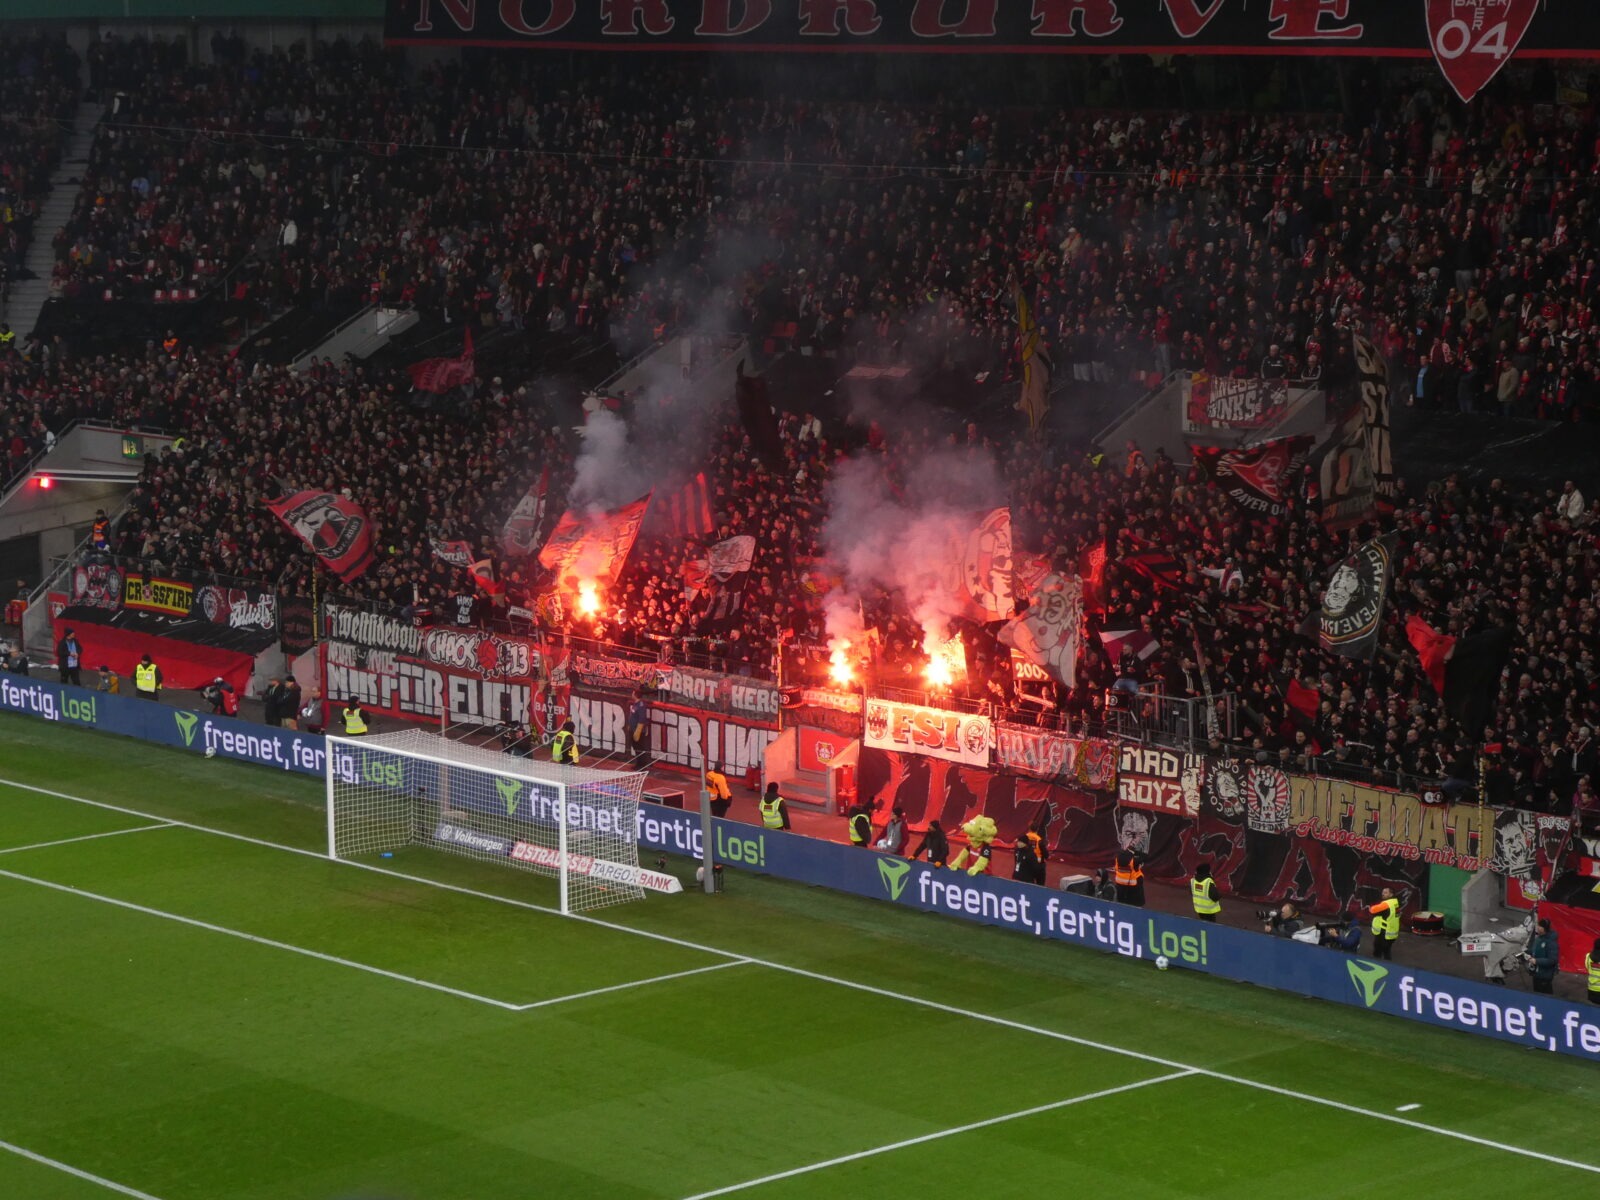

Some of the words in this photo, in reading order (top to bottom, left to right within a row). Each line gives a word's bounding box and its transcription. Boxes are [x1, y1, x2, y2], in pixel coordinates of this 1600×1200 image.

[1436, 19, 1508, 60] 04
[1229, 488, 1269, 512] BAYER
[1, 678, 59, 721] fertig,
[61, 690, 96, 723] los!
[534, 703, 566, 715] BAYER
[892, 707, 961, 752] FSI
[203, 720, 290, 770] freenet,
[362, 751, 404, 788] los!
[1121, 746, 1179, 778] MAD
[1119, 777, 1182, 811] BOYZ
[1206, 759, 1240, 812] COMMANDO
[455, 828, 503, 850] Volkswagen
[530, 787, 632, 843] freenet,
[717, 826, 766, 867] los!
[1424, 845, 1455, 866] mit
[918, 871, 1041, 935] freenet,
[1046, 898, 1142, 958] fertig,
[1148, 918, 1208, 965] los!
[1399, 976, 1556, 1052] freenet,
